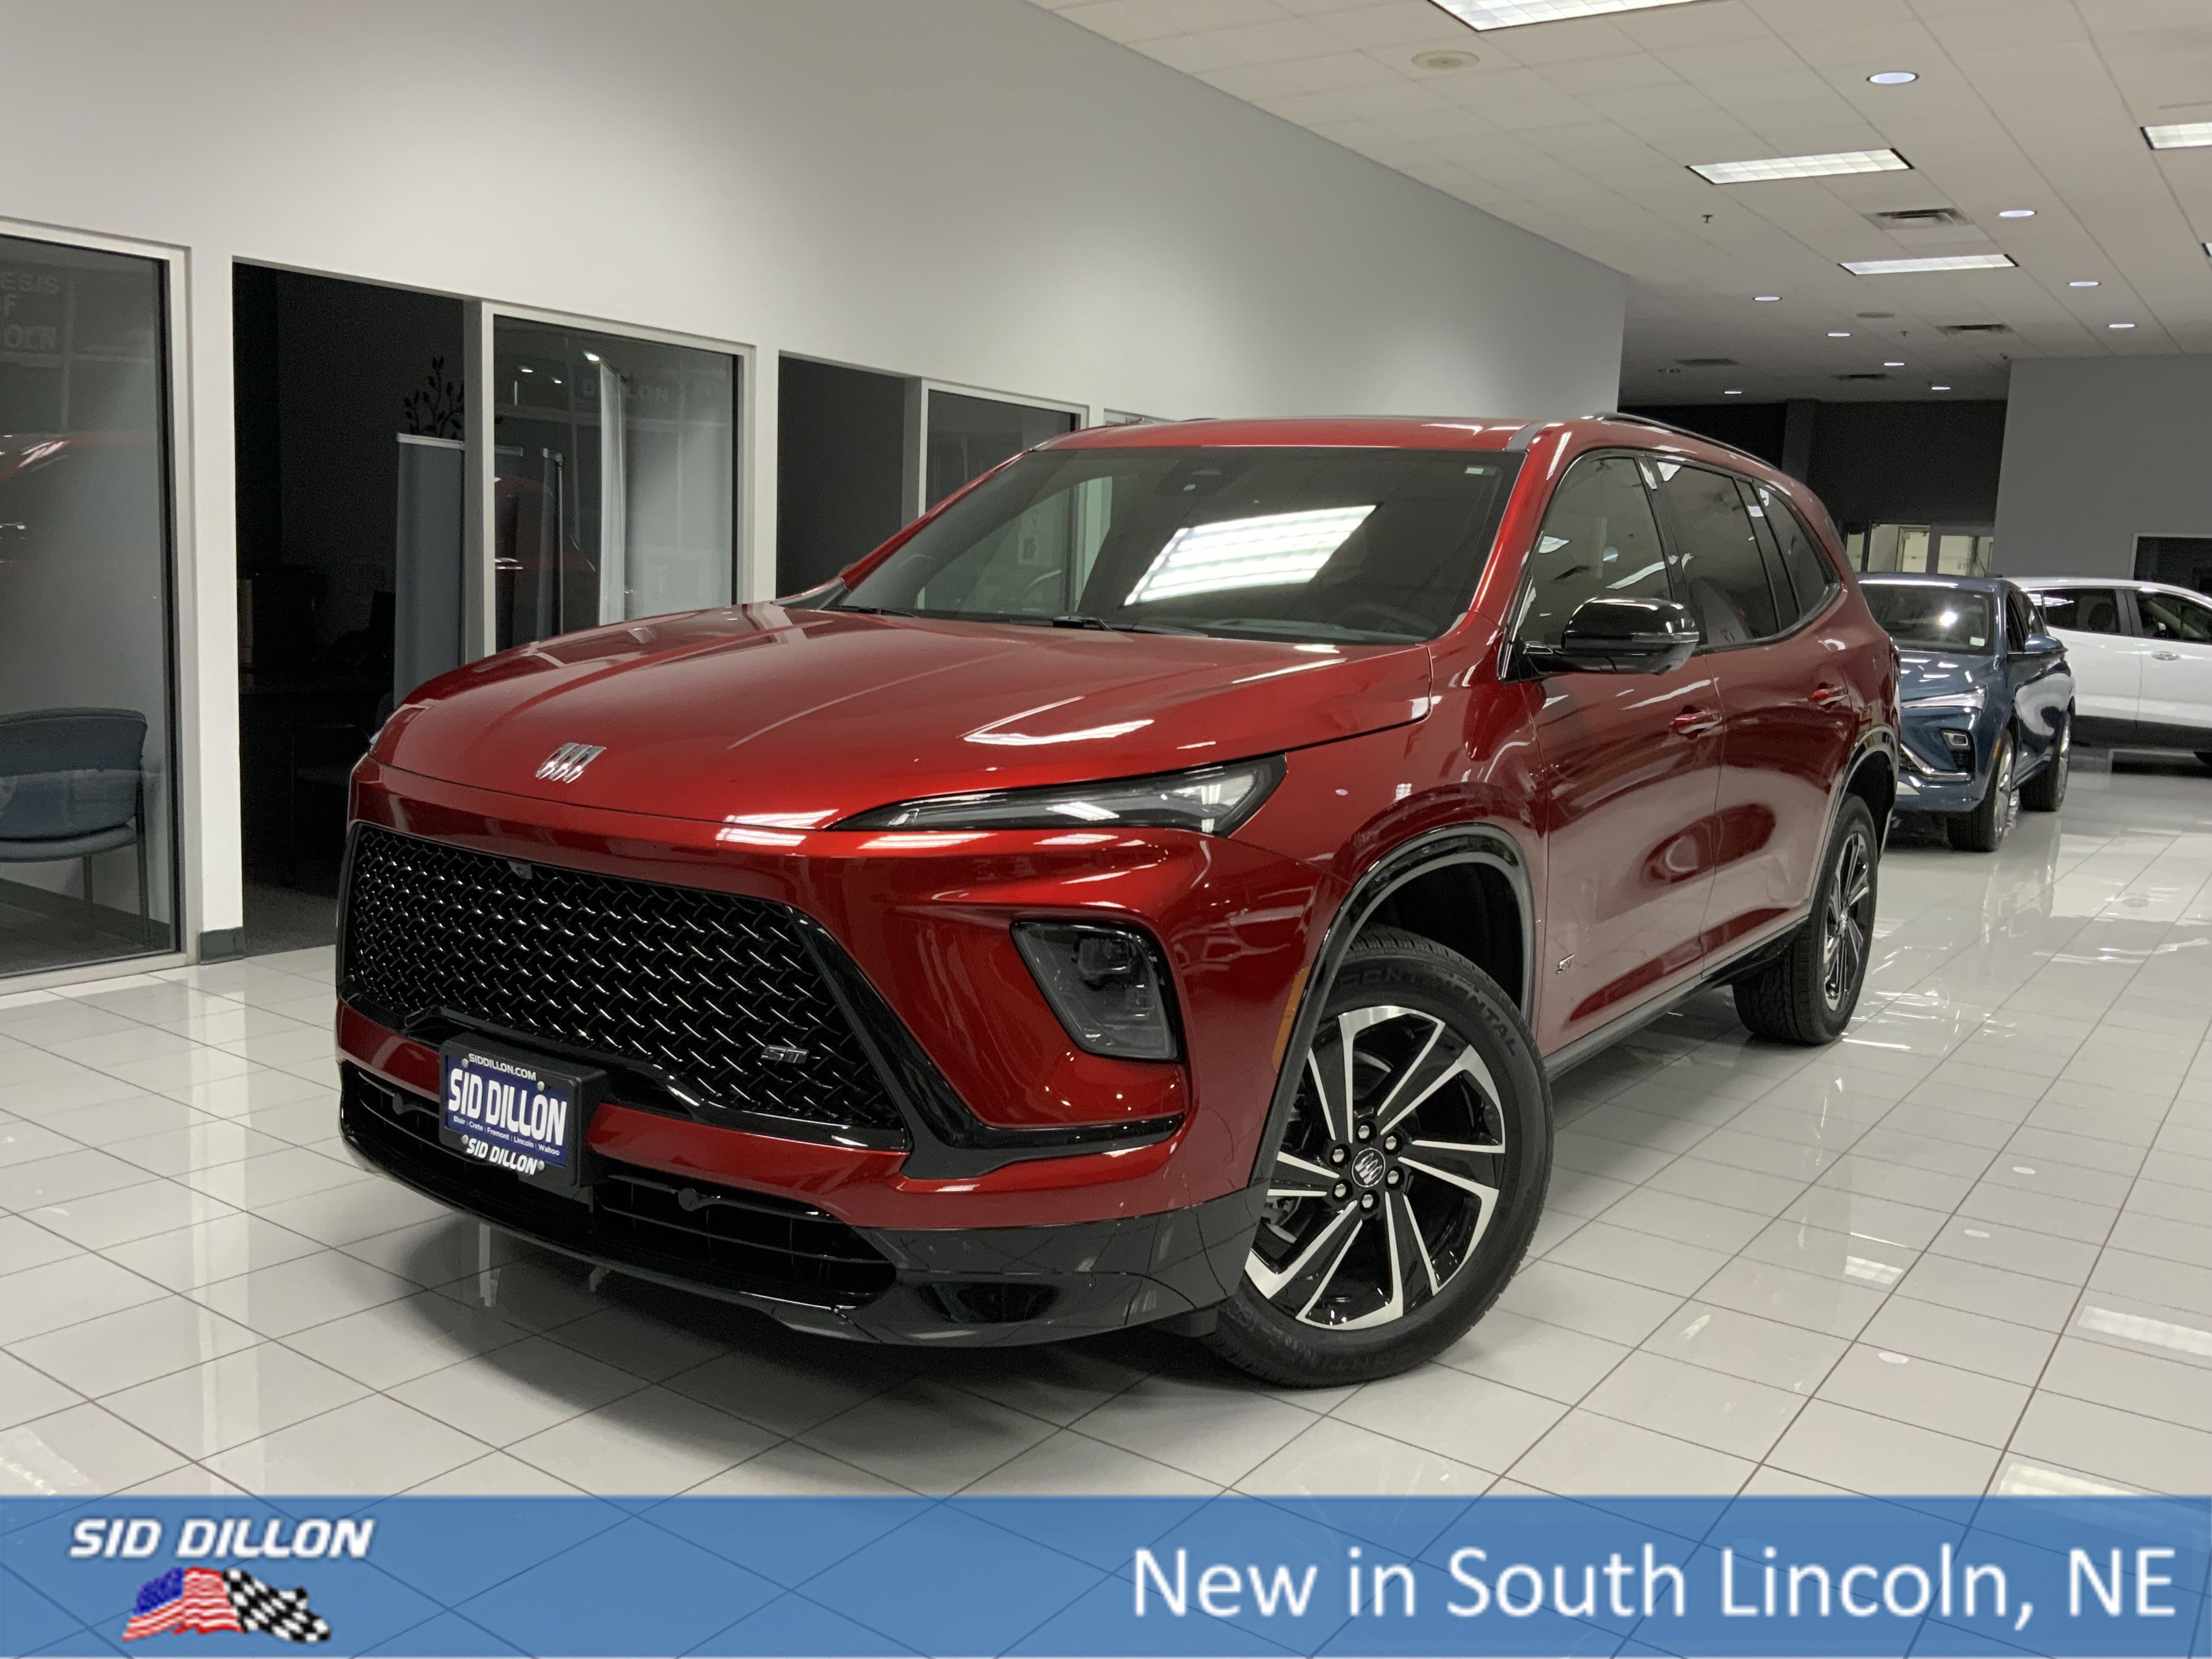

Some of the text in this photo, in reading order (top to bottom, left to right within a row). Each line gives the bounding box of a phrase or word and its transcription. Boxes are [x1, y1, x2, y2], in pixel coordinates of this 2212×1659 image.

[468, 1053, 537, 1081] SIDDILLON.COM
[761, 1046, 808, 1063] ST
[448, 1068, 567, 1146] SID DILLON
[469, 1121, 484, 1132] Crete
[487, 1127, 510, 1140] Fremont
[514, 1136, 534, 1148] Lincoln
[538, 1144, 560, 1156] Wahoo
[466, 1138, 538, 1175] SID DILLON
